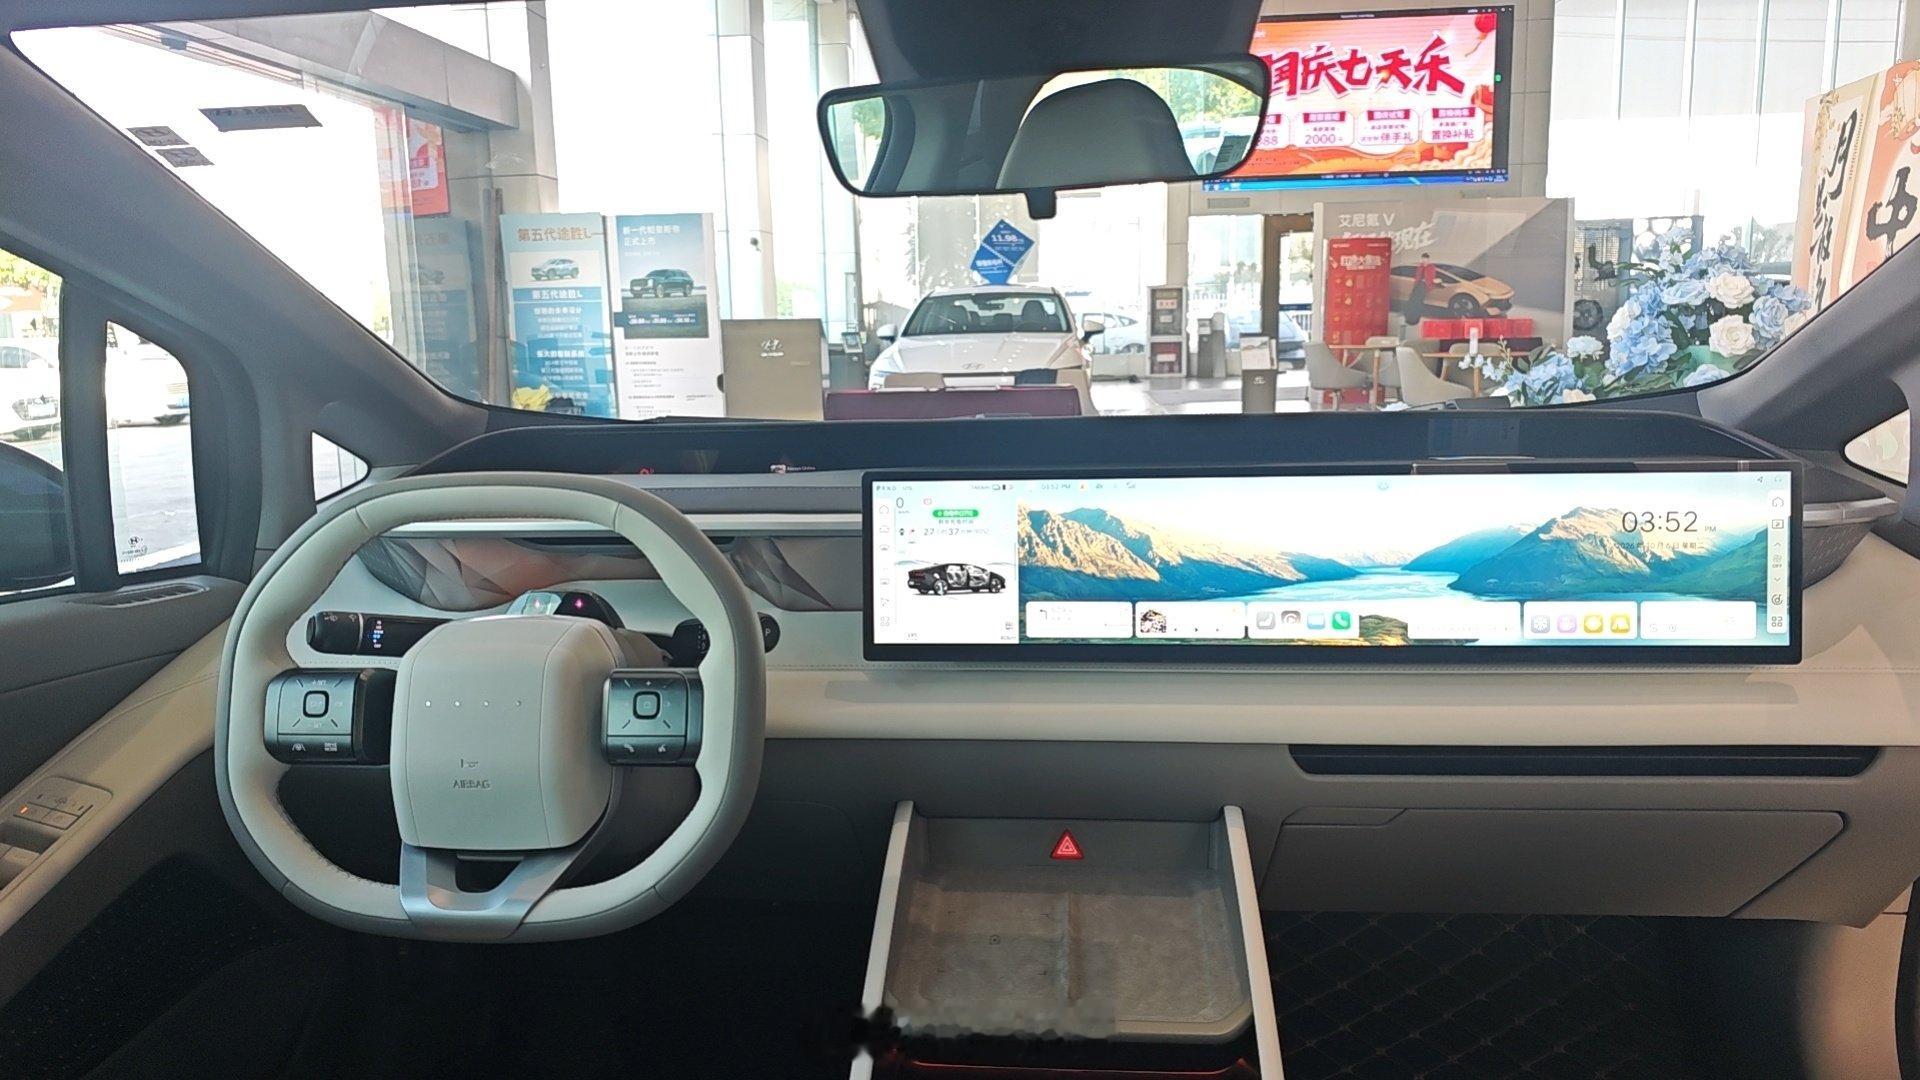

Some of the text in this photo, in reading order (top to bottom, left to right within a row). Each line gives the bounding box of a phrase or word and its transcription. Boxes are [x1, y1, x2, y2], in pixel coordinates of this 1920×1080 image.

[1382, 213, 1396, 226] V
[517, 227, 592, 241] 第五代途胜L
[1622, 511, 1698, 533] 03:52
[765, 628, 772, 637] P
[453, 779, 491, 790] AIRBAG
